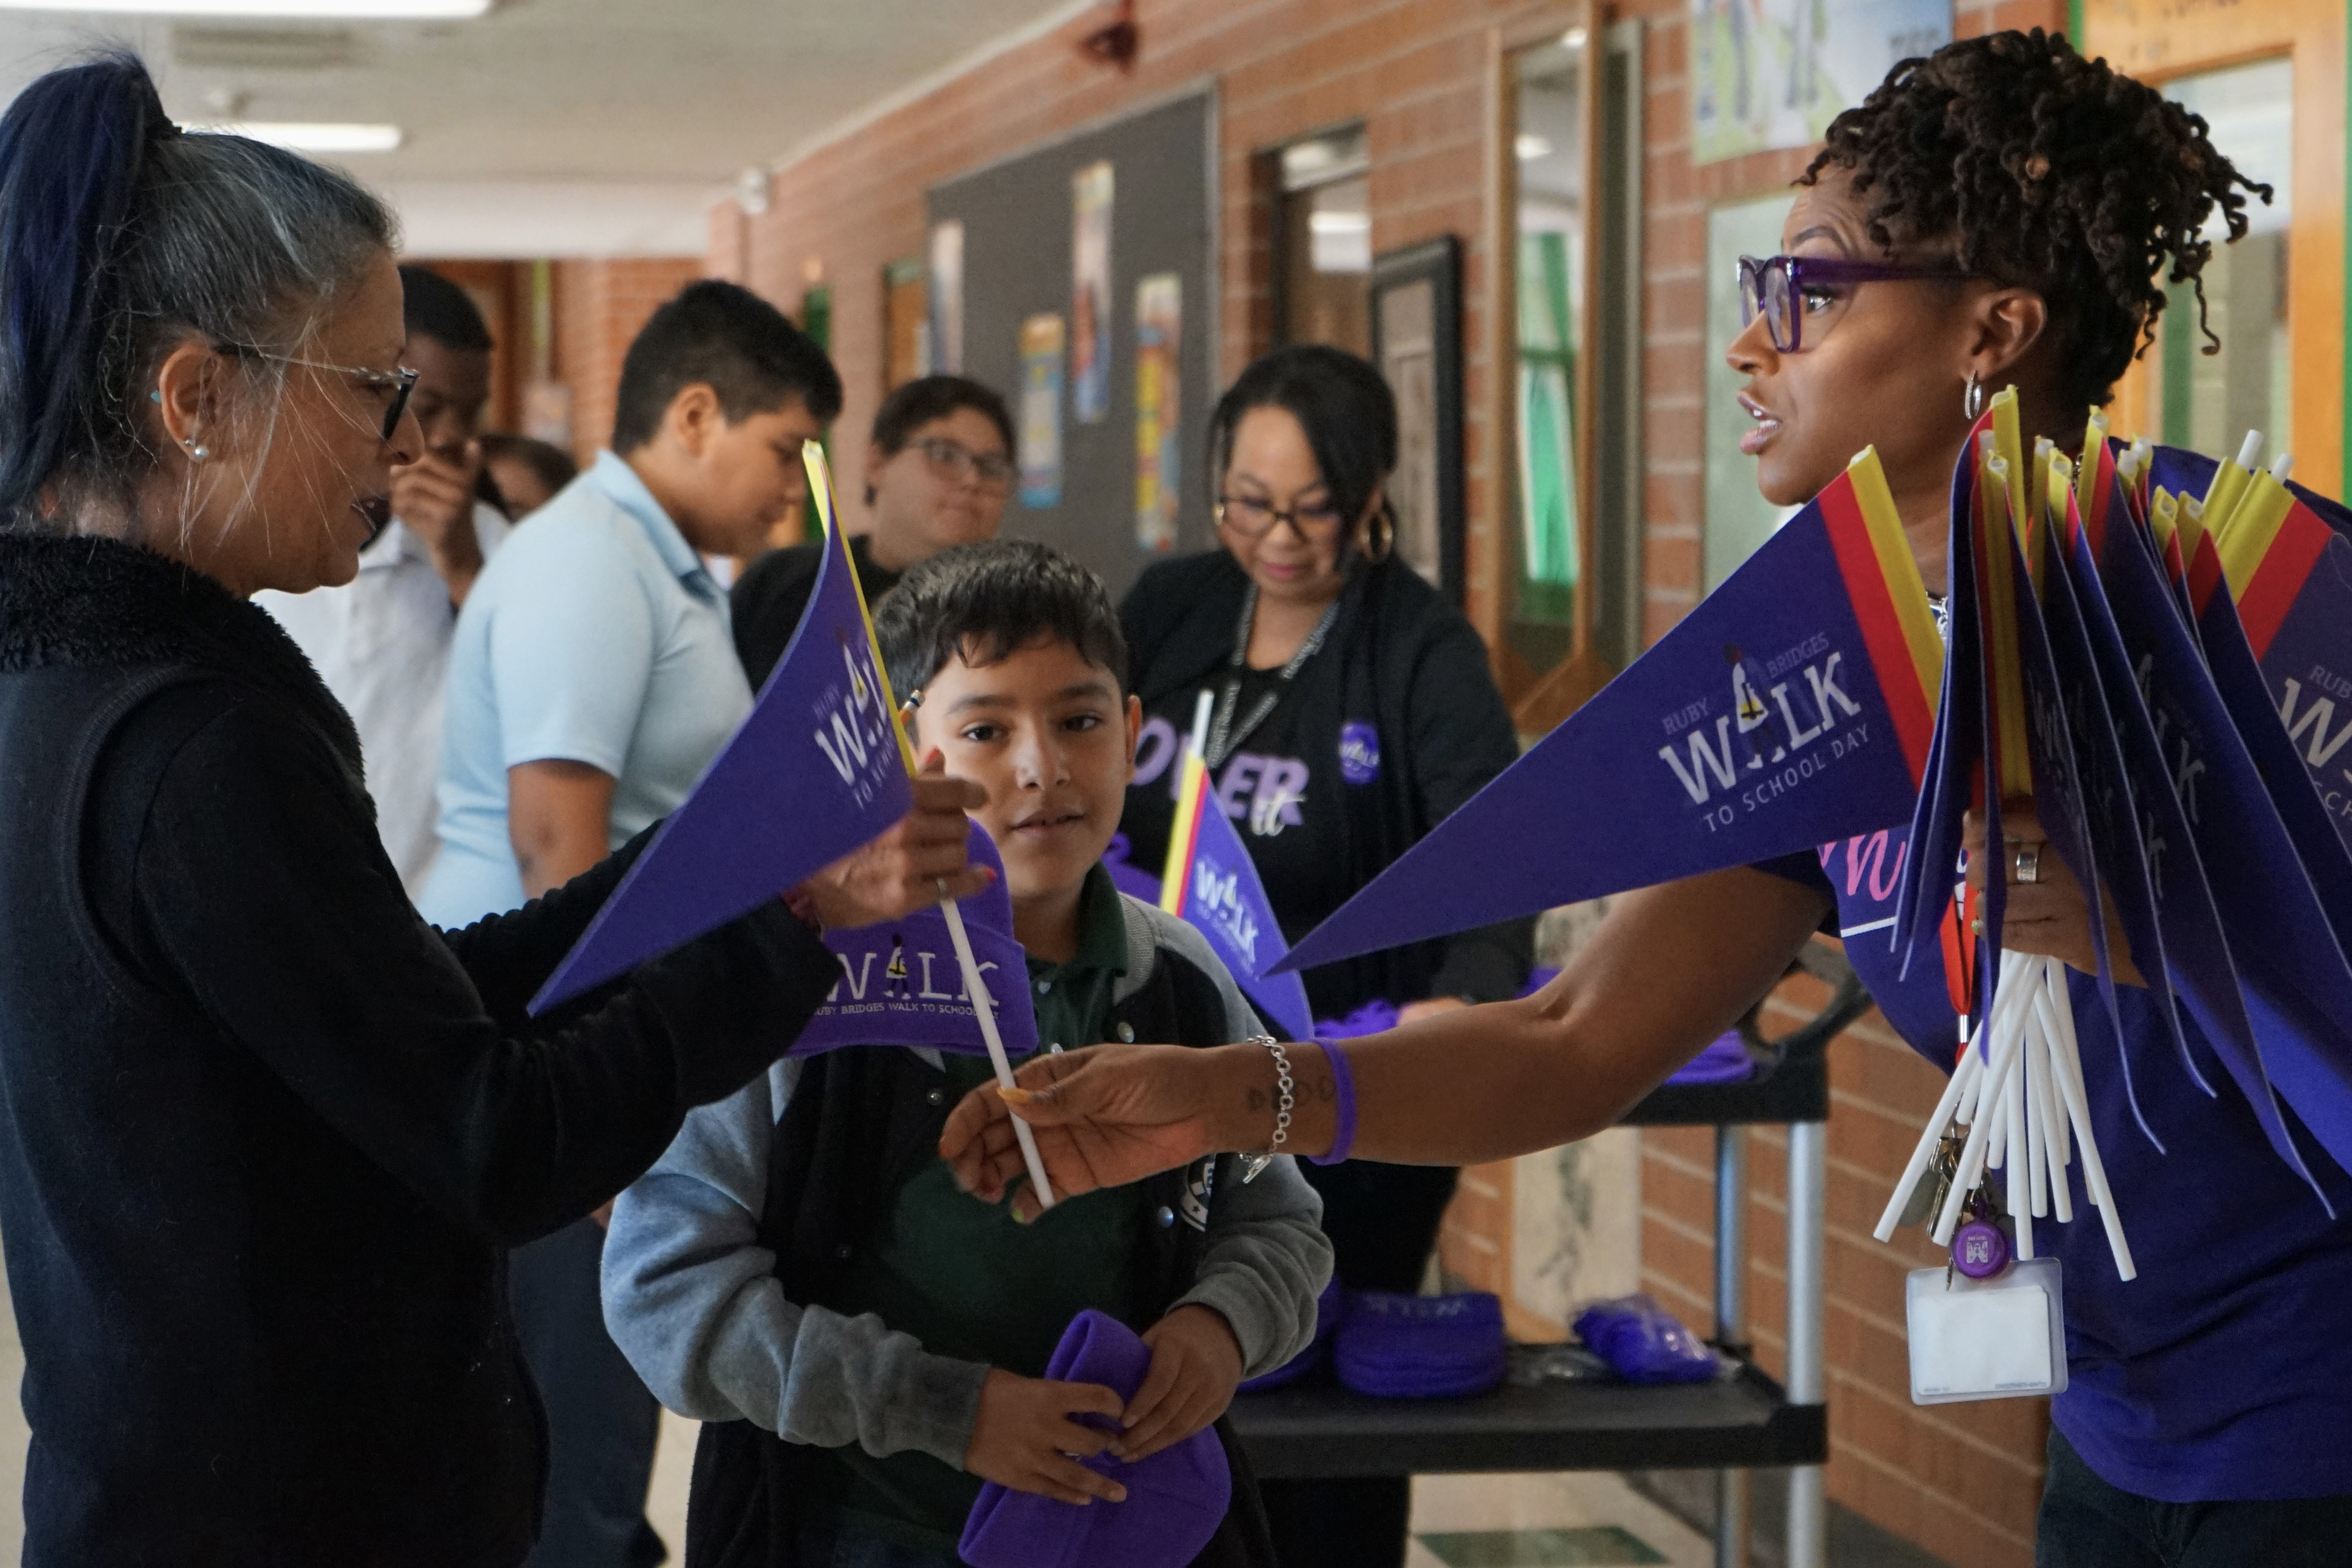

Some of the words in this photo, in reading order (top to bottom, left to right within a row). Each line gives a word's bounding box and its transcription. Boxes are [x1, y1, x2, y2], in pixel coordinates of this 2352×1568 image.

[1658, 650, 1862, 805] WALK
[1663, 698, 1709, 735] RUBY
[1767, 632, 1829, 679] BRIDGES
[2308, 665, 2352, 698] RUB
[1703, 805, 1734, 832] TO
[1742, 752, 1826, 812] SCHOOL
[1830, 723, 1869, 759] DAY
[841, 1002, 885, 1015] BRIDGES
[888, 1002, 919, 1012] WALK
[922, 1003, 936, 1013] TO
